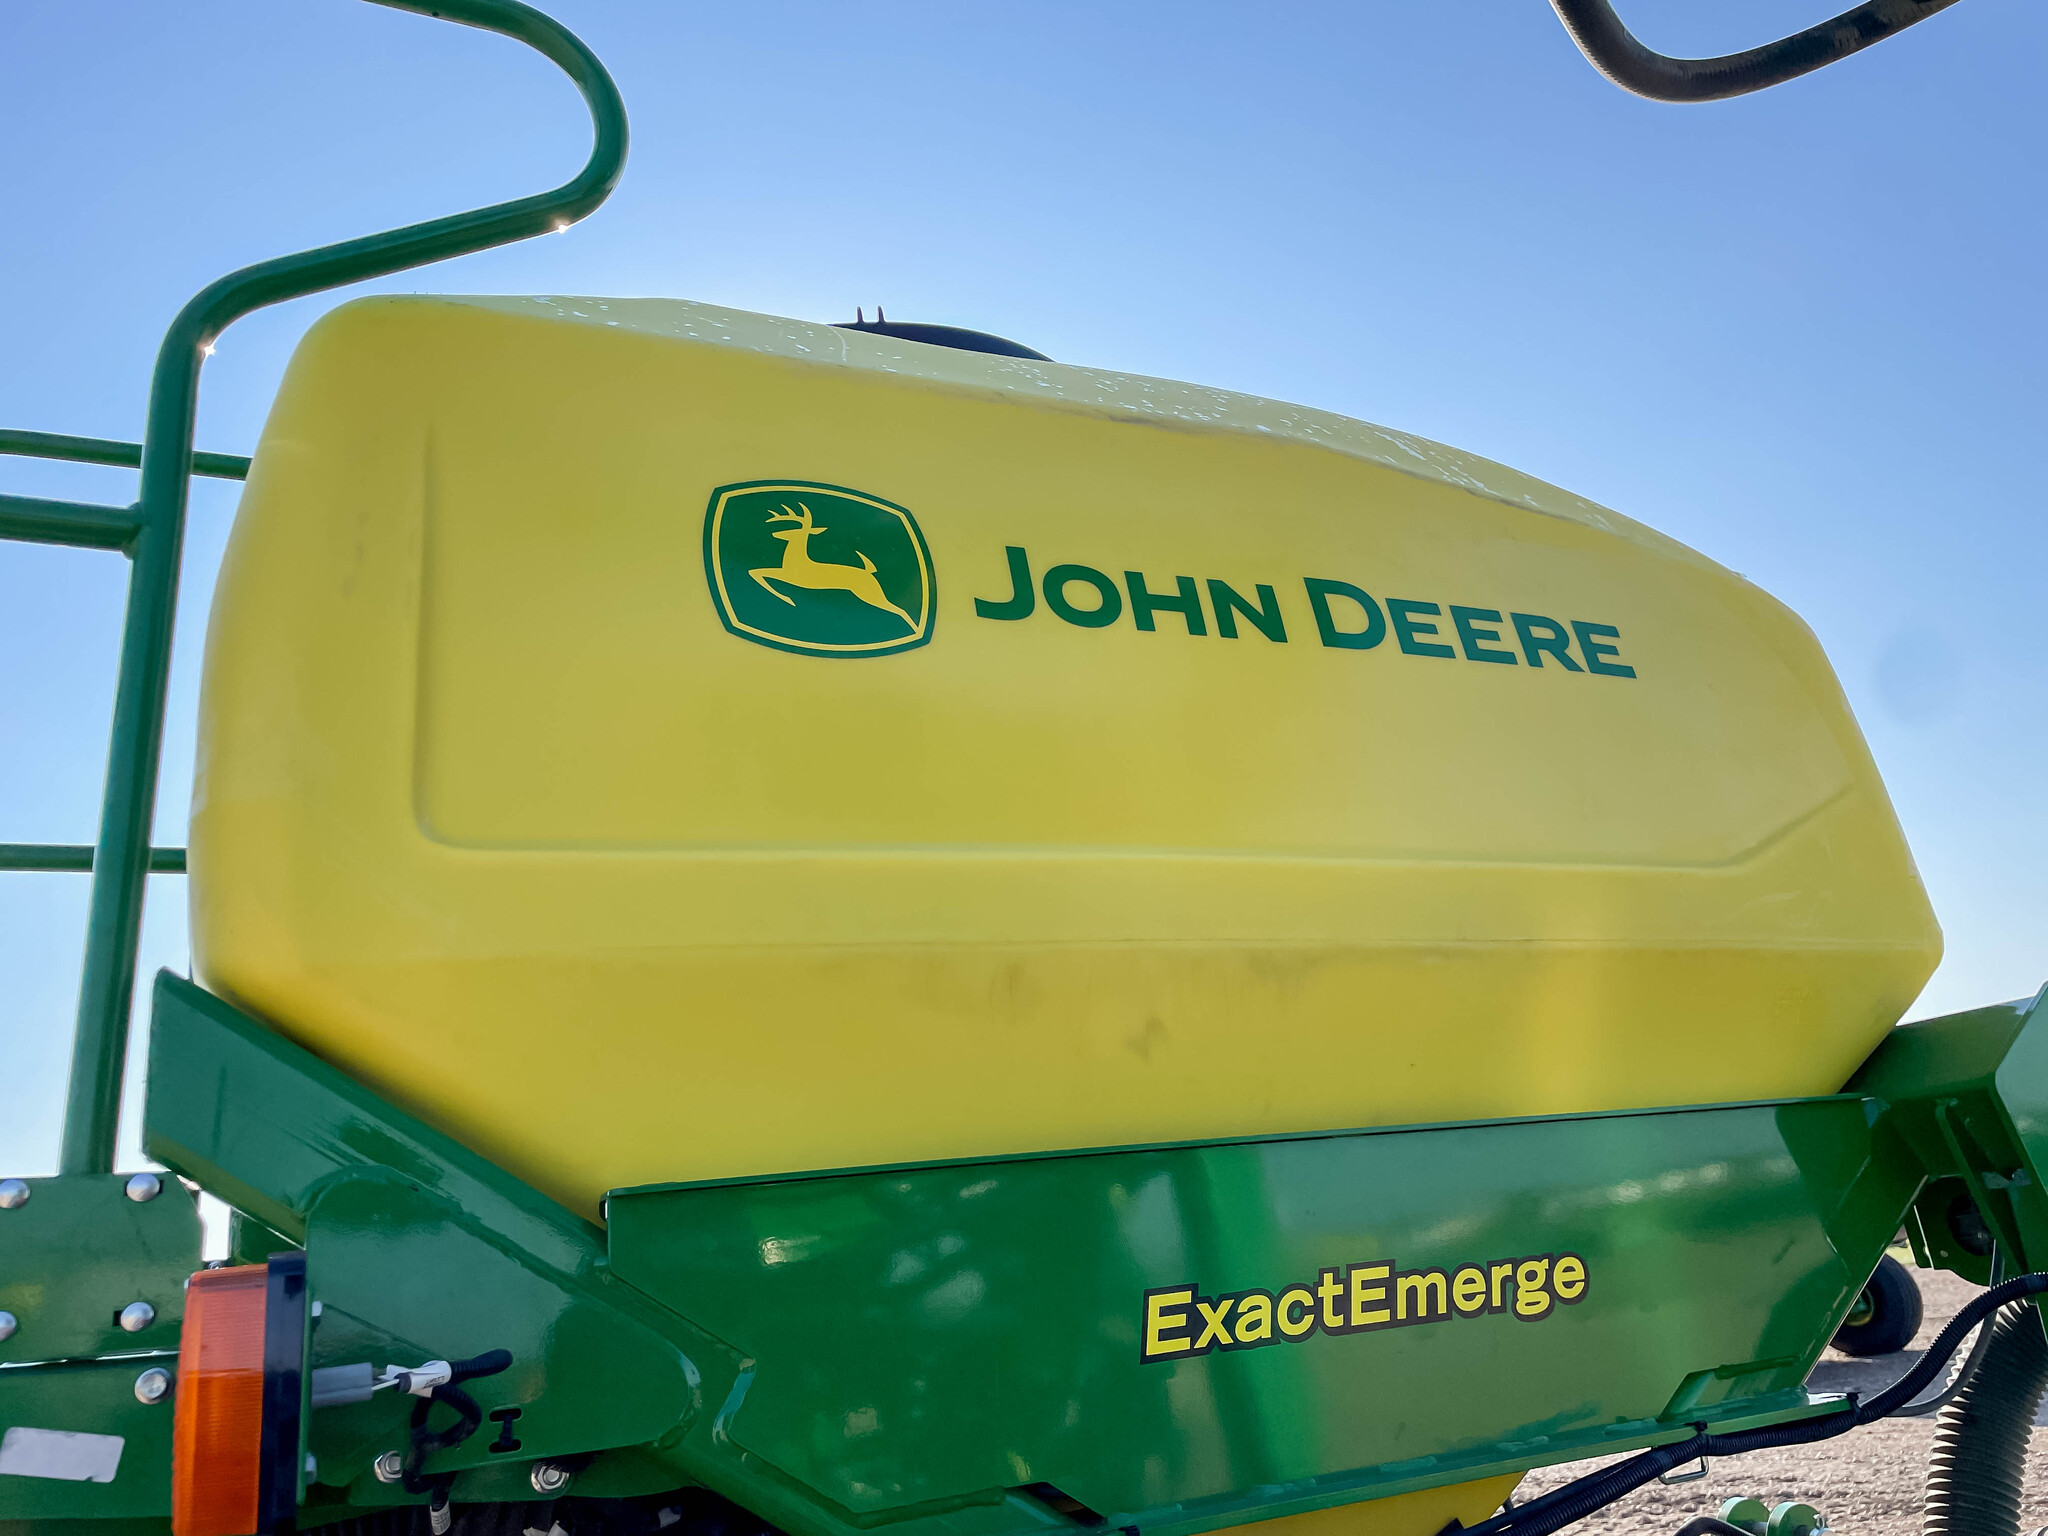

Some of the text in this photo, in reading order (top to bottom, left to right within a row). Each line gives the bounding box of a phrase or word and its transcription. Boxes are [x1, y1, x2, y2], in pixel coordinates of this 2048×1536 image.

[974, 545, 1637, 679] JOHN DEERE
[1144, 1255, 1586, 1356] ExactEmerge
